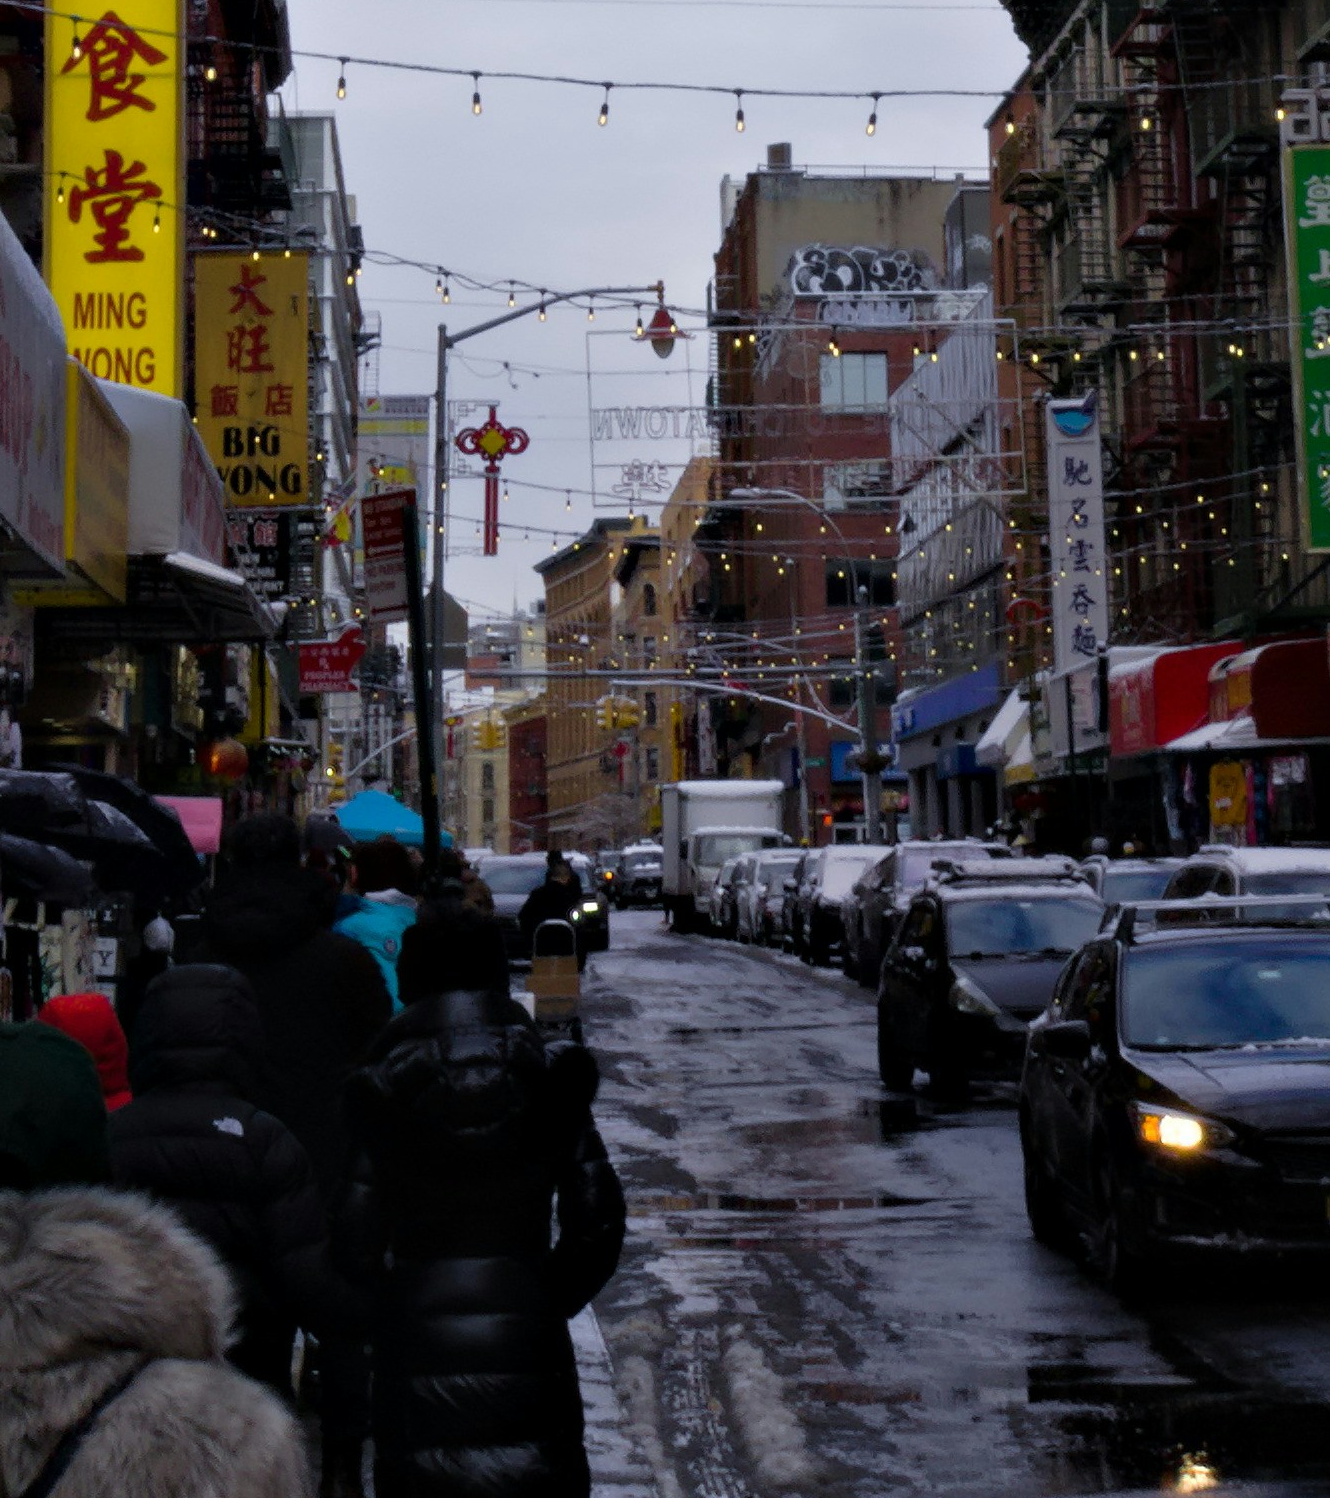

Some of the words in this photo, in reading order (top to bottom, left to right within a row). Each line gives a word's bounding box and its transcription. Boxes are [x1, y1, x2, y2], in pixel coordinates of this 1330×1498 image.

[73, 291, 147, 329] MING
[228, 263, 274, 373] 大旺
[222, 426, 281, 457] BIG
